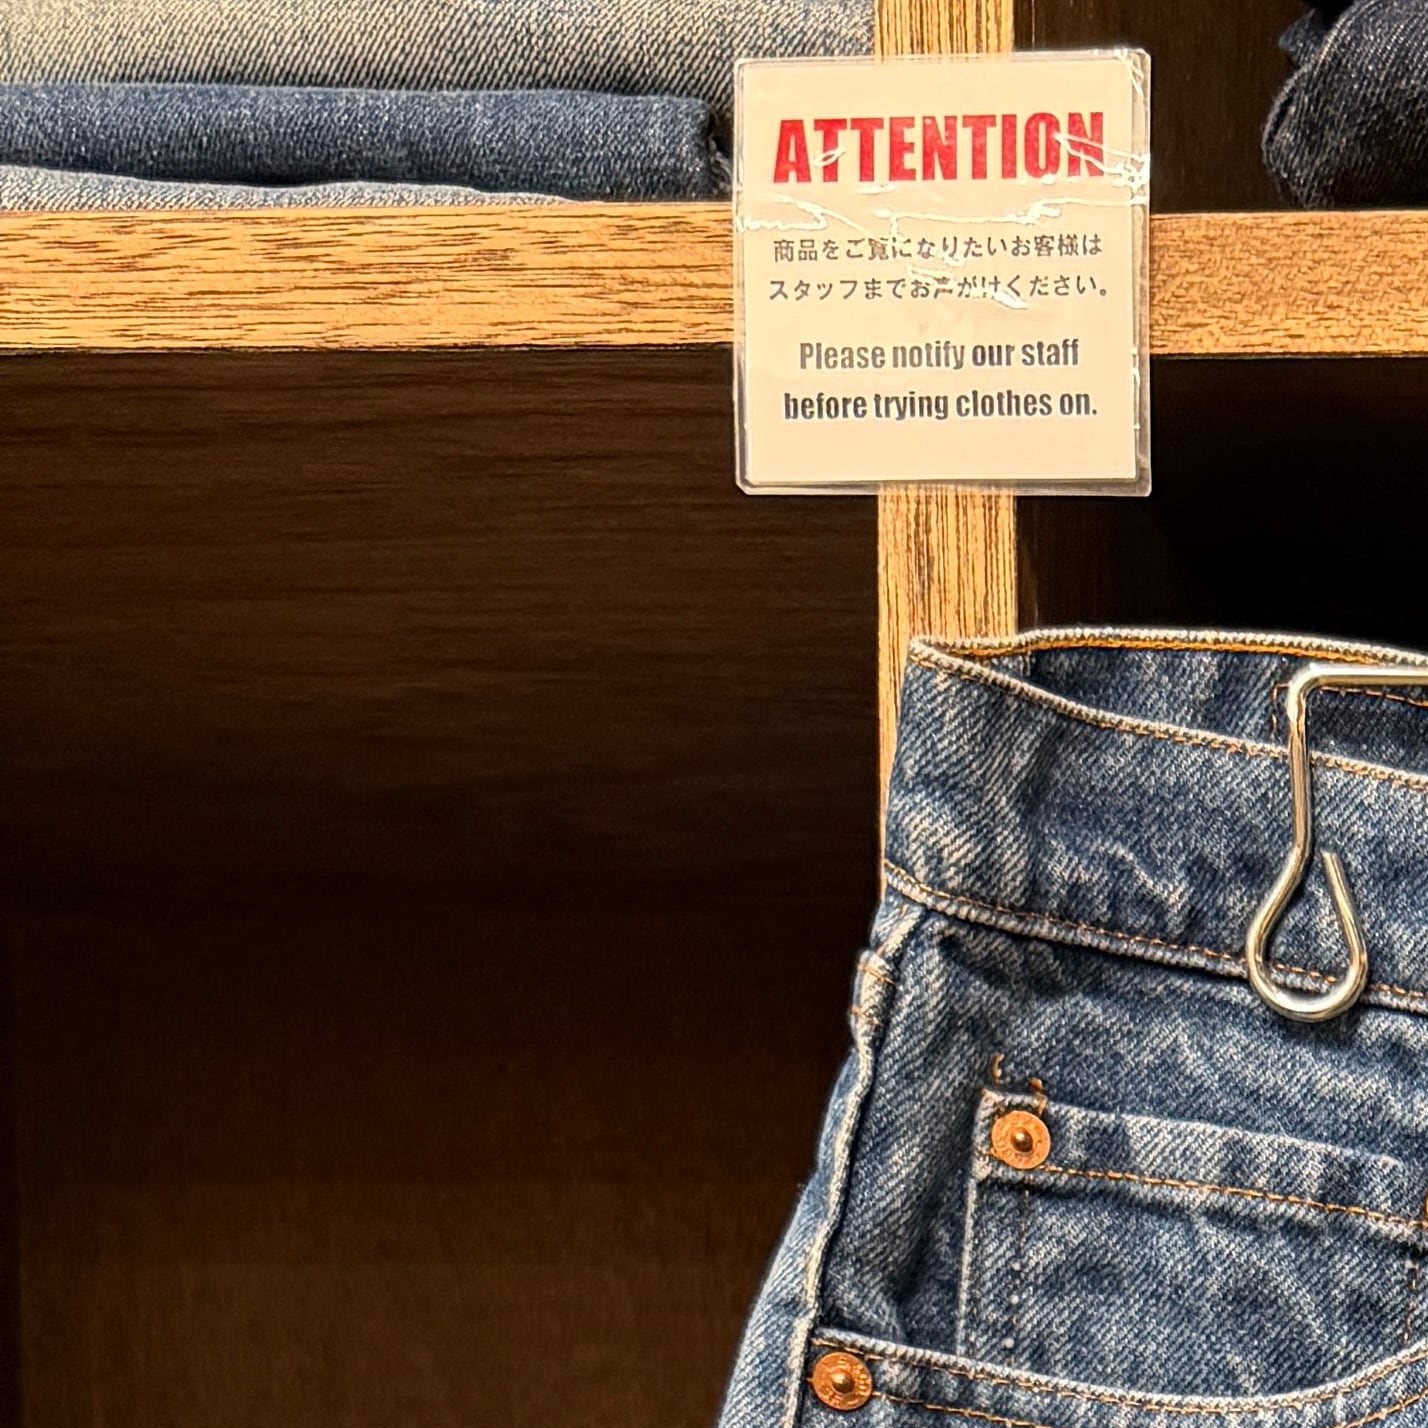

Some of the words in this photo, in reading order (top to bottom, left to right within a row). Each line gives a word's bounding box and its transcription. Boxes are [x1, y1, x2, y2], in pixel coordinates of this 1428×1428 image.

[773, 112, 1104, 183] ATTENTION
[773, 233, 1103, 262] 商品をご覧になりたいお客様は
[799, 341, 886, 370] Please
[891, 341, 965, 370] notify
[971, 345, 1015, 367] our
[1020, 339, 1080, 366] staff
[784, 392, 868, 420] before
[873, 392, 949, 421] trying
[955, 389, 1053, 416] clothes
[1059, 390, 1098, 416] on.
